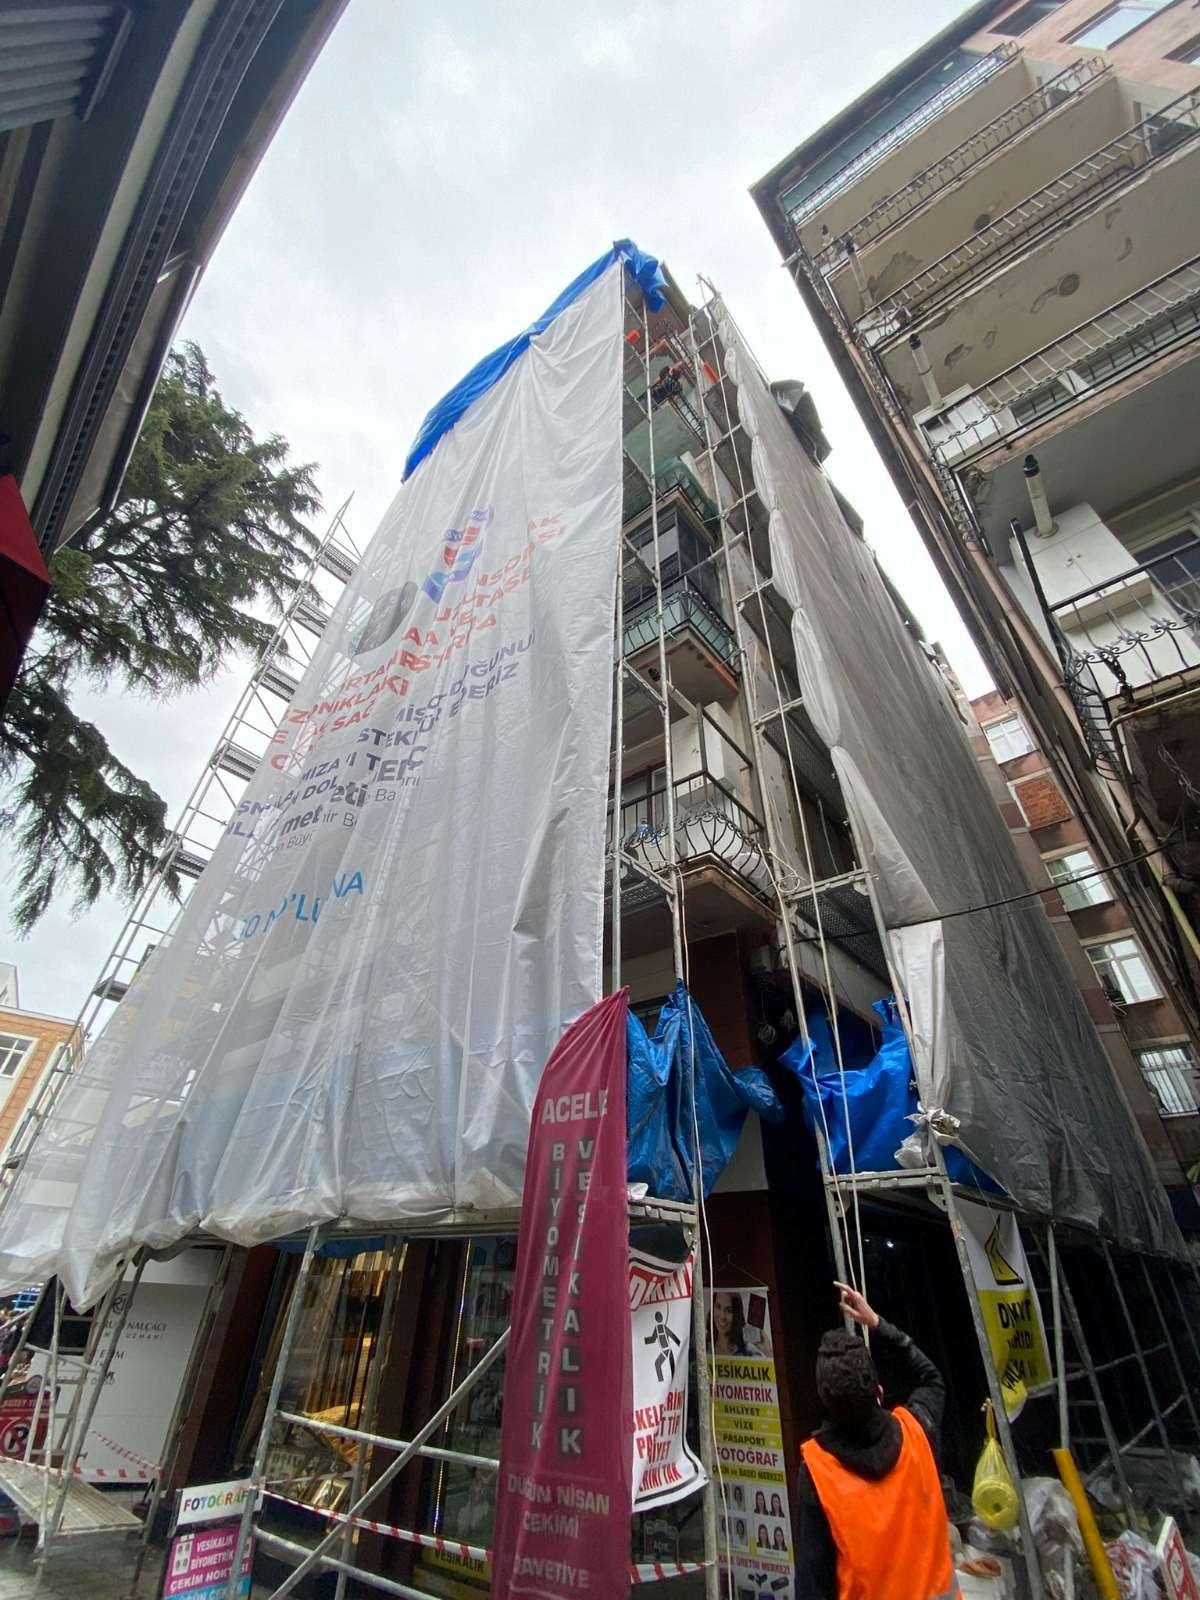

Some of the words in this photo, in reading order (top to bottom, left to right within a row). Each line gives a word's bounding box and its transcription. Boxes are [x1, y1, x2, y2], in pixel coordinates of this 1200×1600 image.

[281, 804, 323, 836] met
[709, 1362, 770, 1381] VESİKALIK
[709, 1383, 773, 1402] BİYOMETRİK
[724, 1404, 760, 1417] EHLİYET
[734, 1420, 754, 1431] VİZE
[723, 1433, 766, 1446] PASAPORT
[716, 1446, 778, 1467] FOTOĞRAF
[171, 1573, 204, 1593] ÇEKİM
